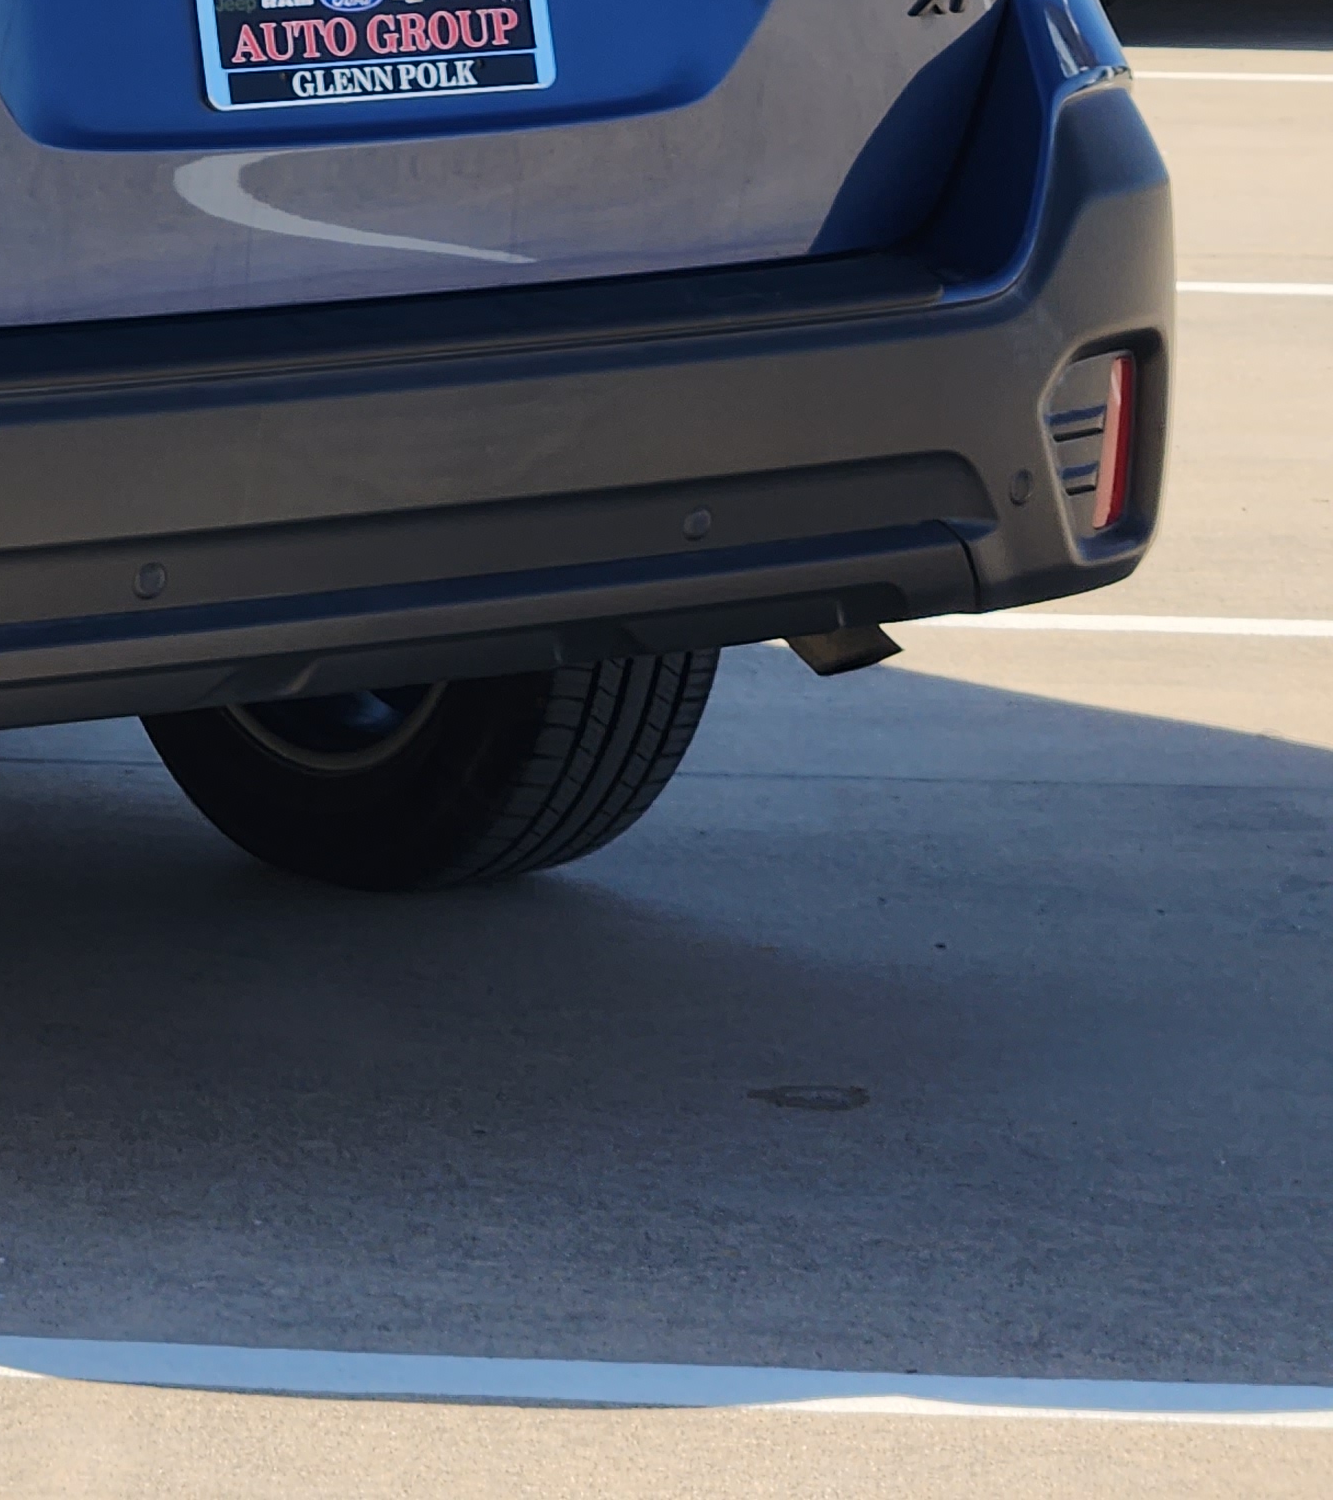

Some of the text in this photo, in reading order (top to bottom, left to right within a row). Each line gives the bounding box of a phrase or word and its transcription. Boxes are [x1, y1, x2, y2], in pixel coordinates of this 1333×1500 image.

[231, 8, 518, 63] AUTO GROUP
[292, 60, 478, 97] GLENN POLK
